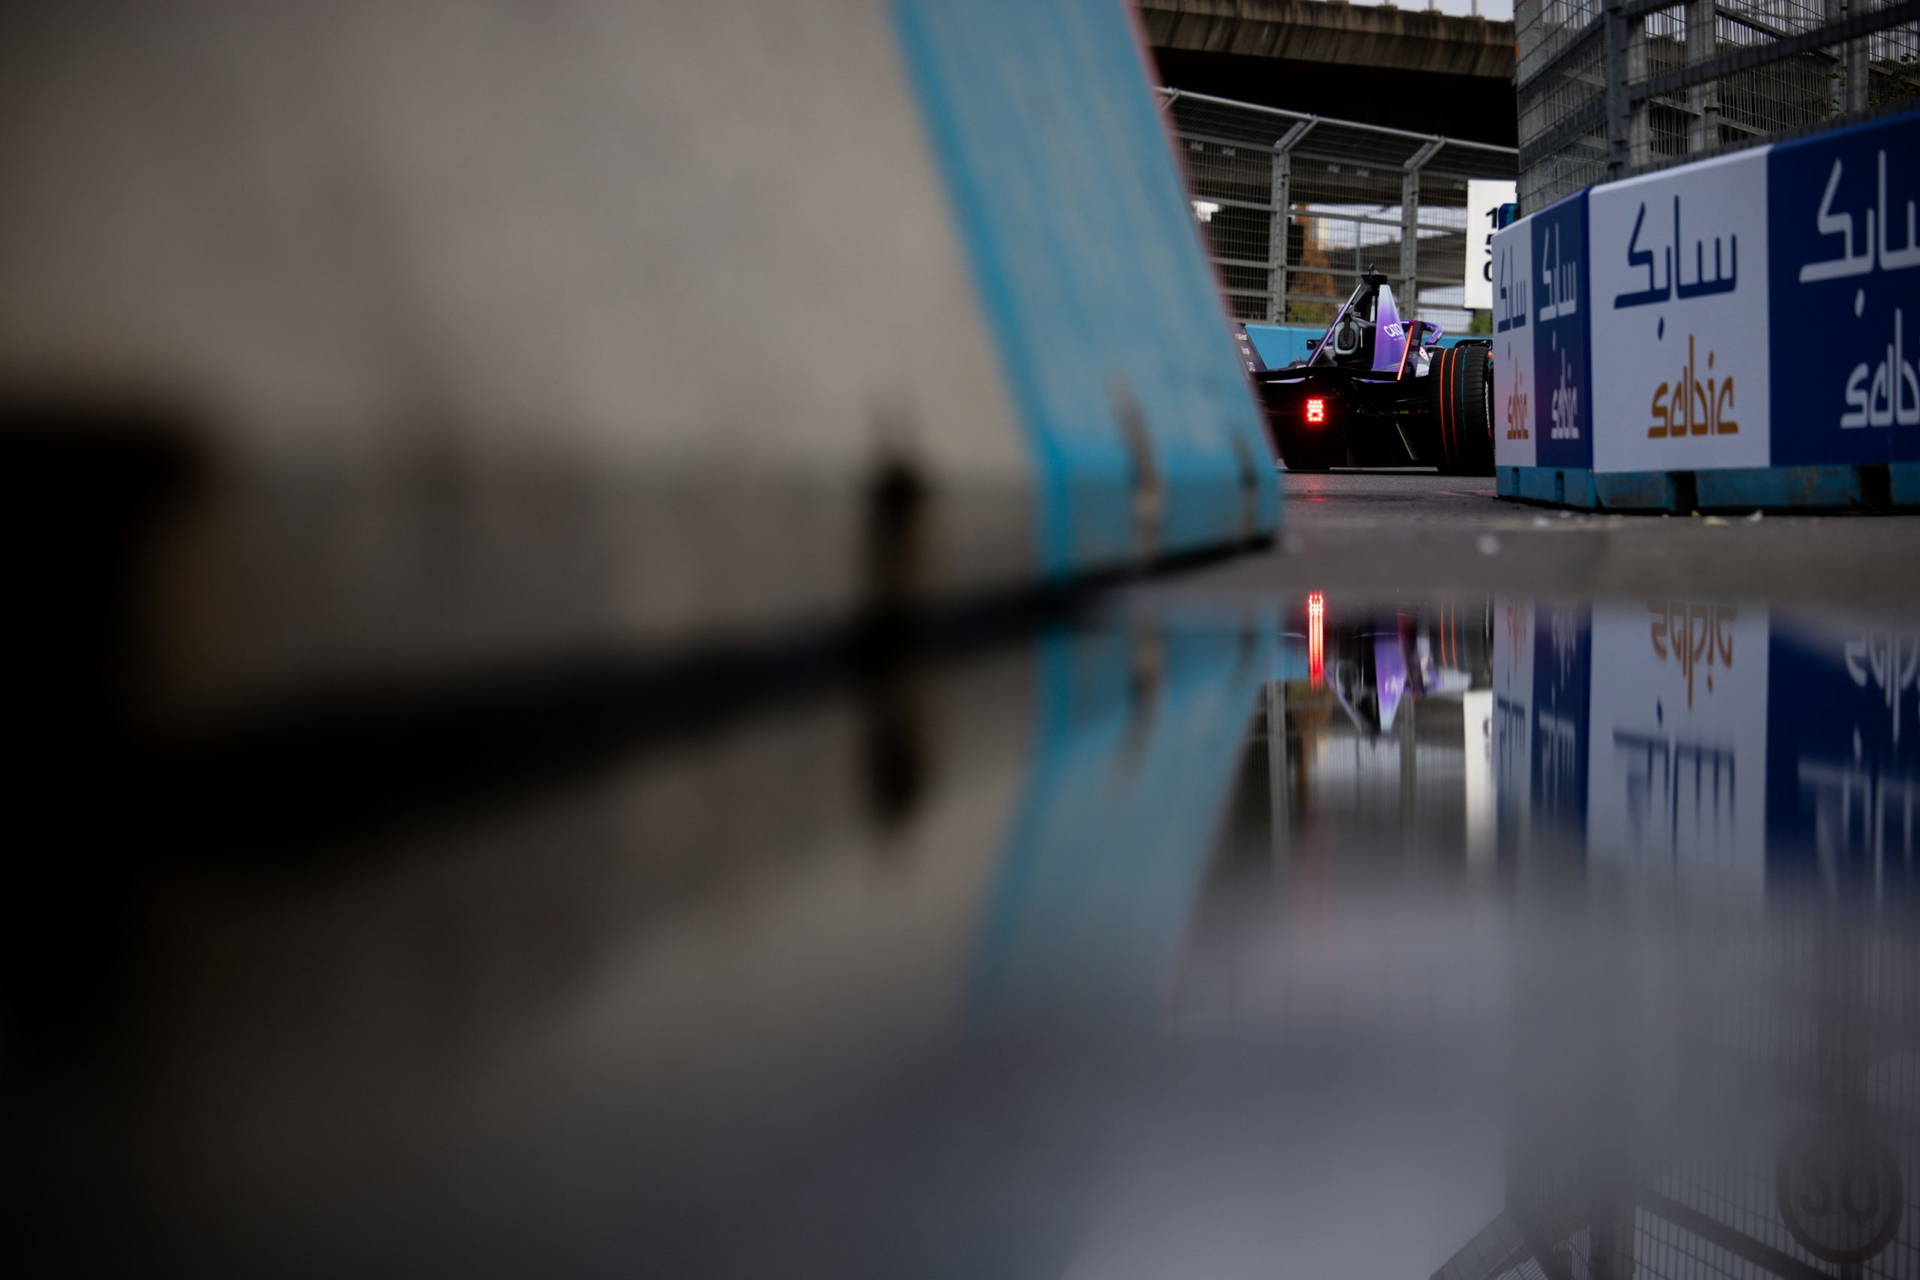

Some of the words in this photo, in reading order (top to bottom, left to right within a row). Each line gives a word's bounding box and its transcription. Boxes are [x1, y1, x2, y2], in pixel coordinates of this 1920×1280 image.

[1613, 195, 1737, 341] سابك
[1507, 357, 1529, 440] sabic
[1551, 348, 1580, 440] sabic
[1648, 333, 1739, 439] sabic
[1840, 307, 1920, 430] sab
